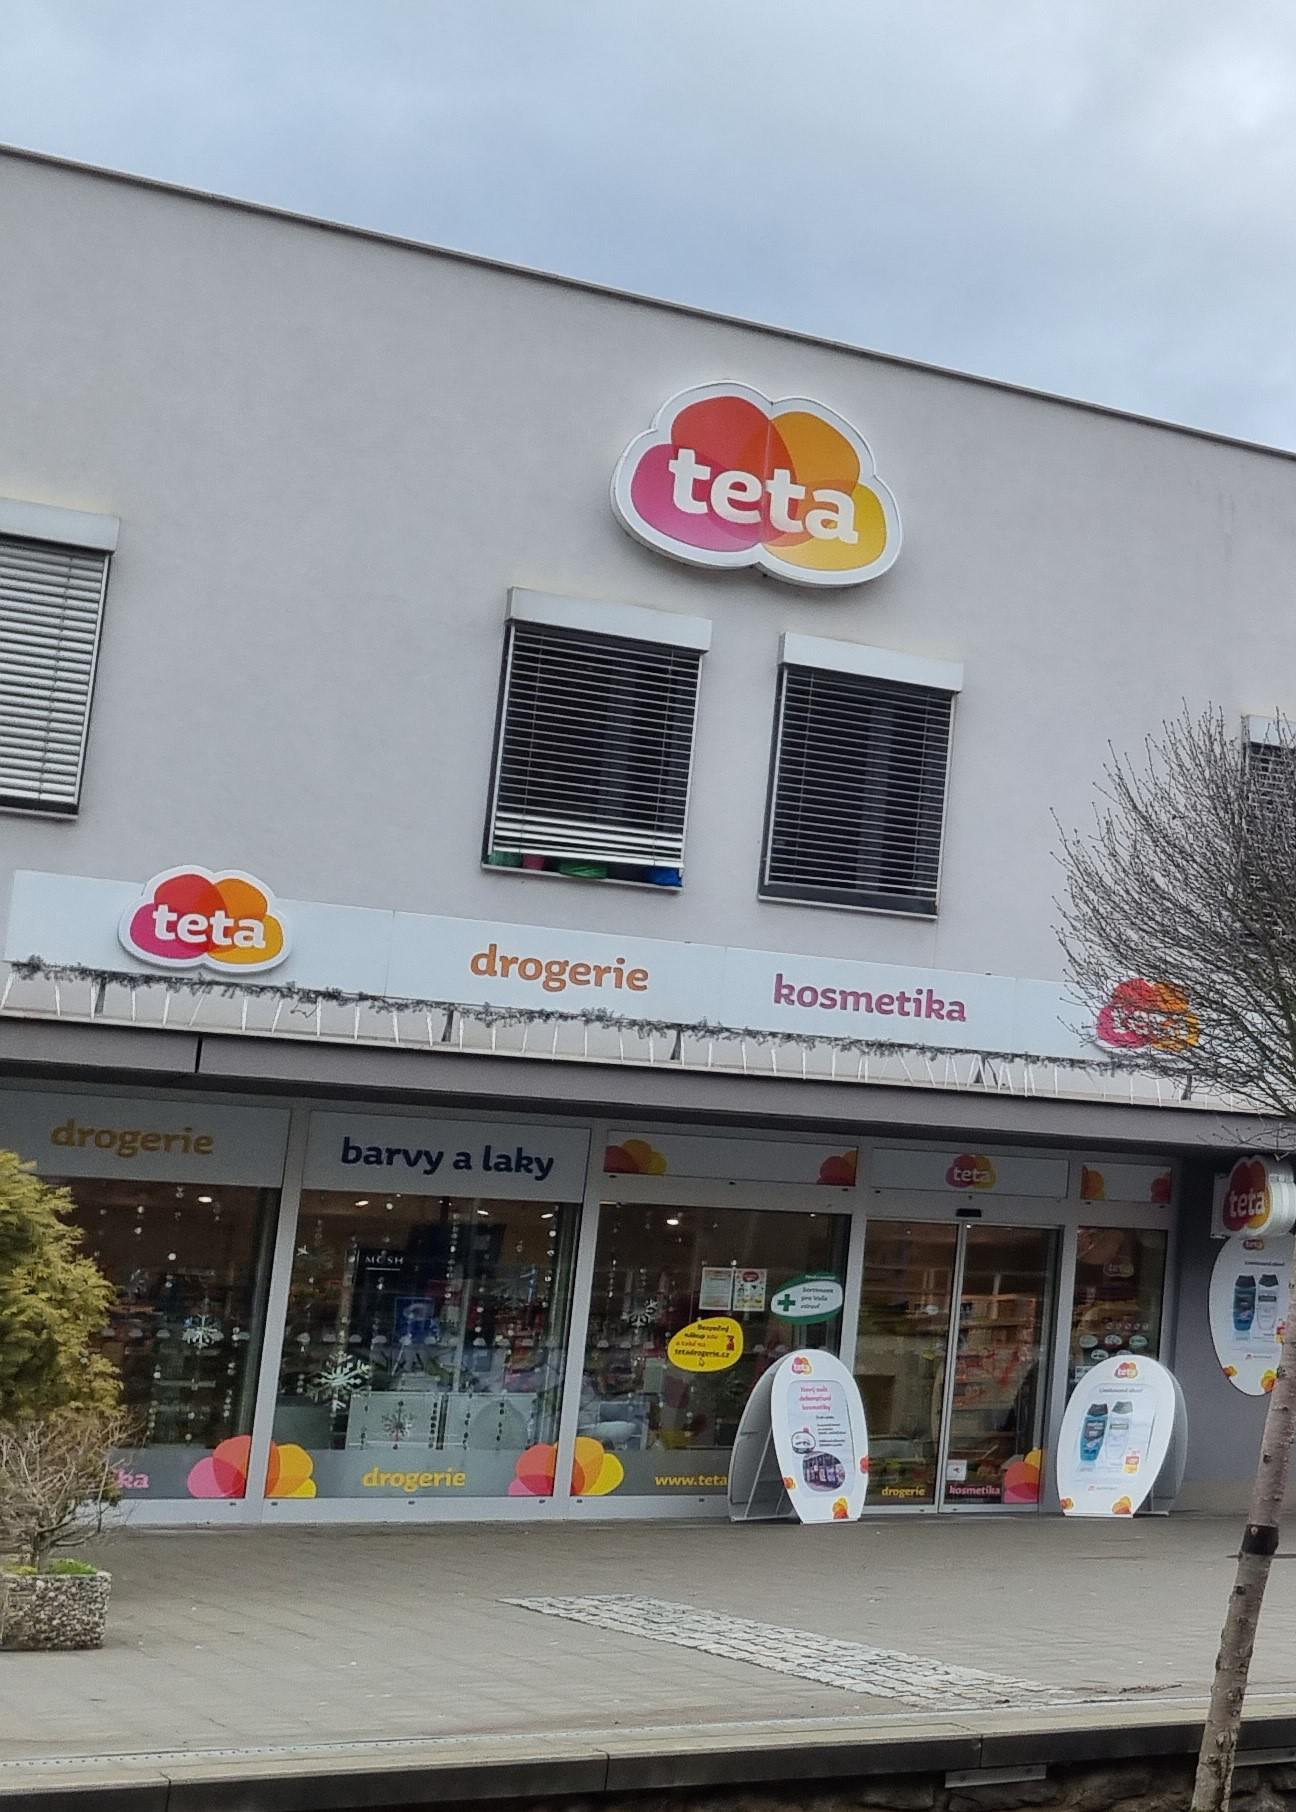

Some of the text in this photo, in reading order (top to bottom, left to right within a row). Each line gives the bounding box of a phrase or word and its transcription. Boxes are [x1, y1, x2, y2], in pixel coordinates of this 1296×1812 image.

[668, 448, 859, 545] teta
[152, 903, 267, 949] teta
[469, 943, 650, 992] drogerie
[773, 973, 967, 1022] kosmetika
[50, 1119, 214, 1158] drogerie
[341, 1136, 554, 1182] barvy a laky
[953, 1166, 992, 1184] teta
[1229, 1190, 1266, 1218] teta
[361, 1466, 466, 1494] drogerie
[881, 1486, 926, 1499] drogerie
[949, 1485, 1000, 1496] kosmetika
